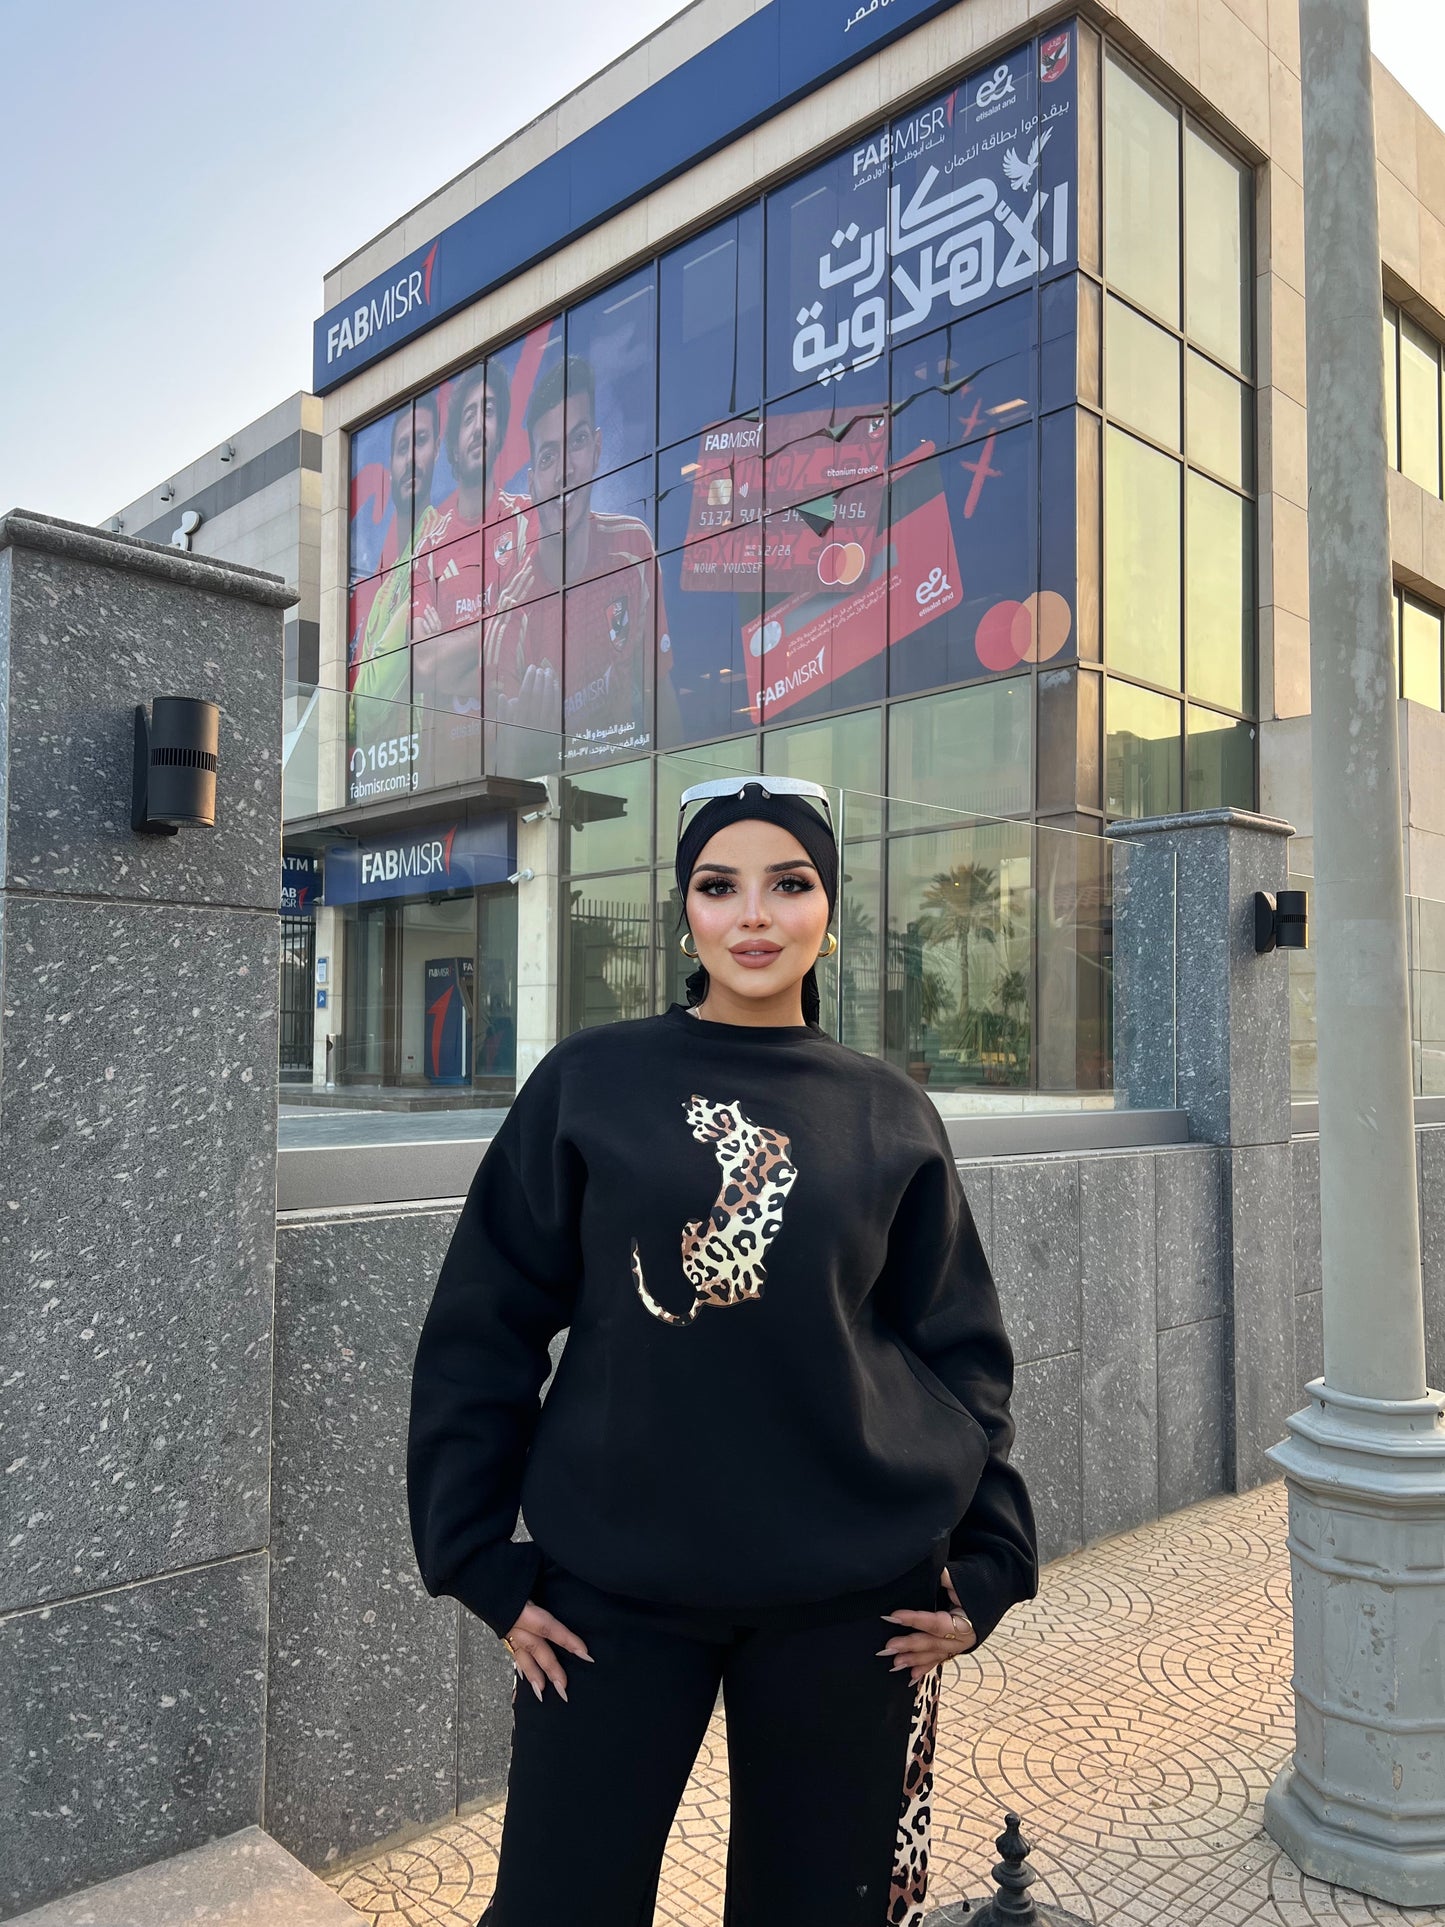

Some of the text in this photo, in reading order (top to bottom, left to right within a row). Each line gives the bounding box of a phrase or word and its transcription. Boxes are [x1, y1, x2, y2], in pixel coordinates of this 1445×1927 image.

[1002, 95, 1017, 109] and
[852, 106, 945, 177] FABMISR
[981, 127, 1018, 151] بطاقة
[818, 164, 998, 298] كارت
[327, 270, 422, 364] FABMISR
[704, 430, 757, 451] FABMISR
[827, 467, 857, 477] titanium
[693, 562, 717, 574] NOUR
[916, 567, 952, 604] e&
[756, 660, 819, 709] FABMISR
[368, 733, 419, 771] 16555
[362, 841, 443, 884] FABMISR
